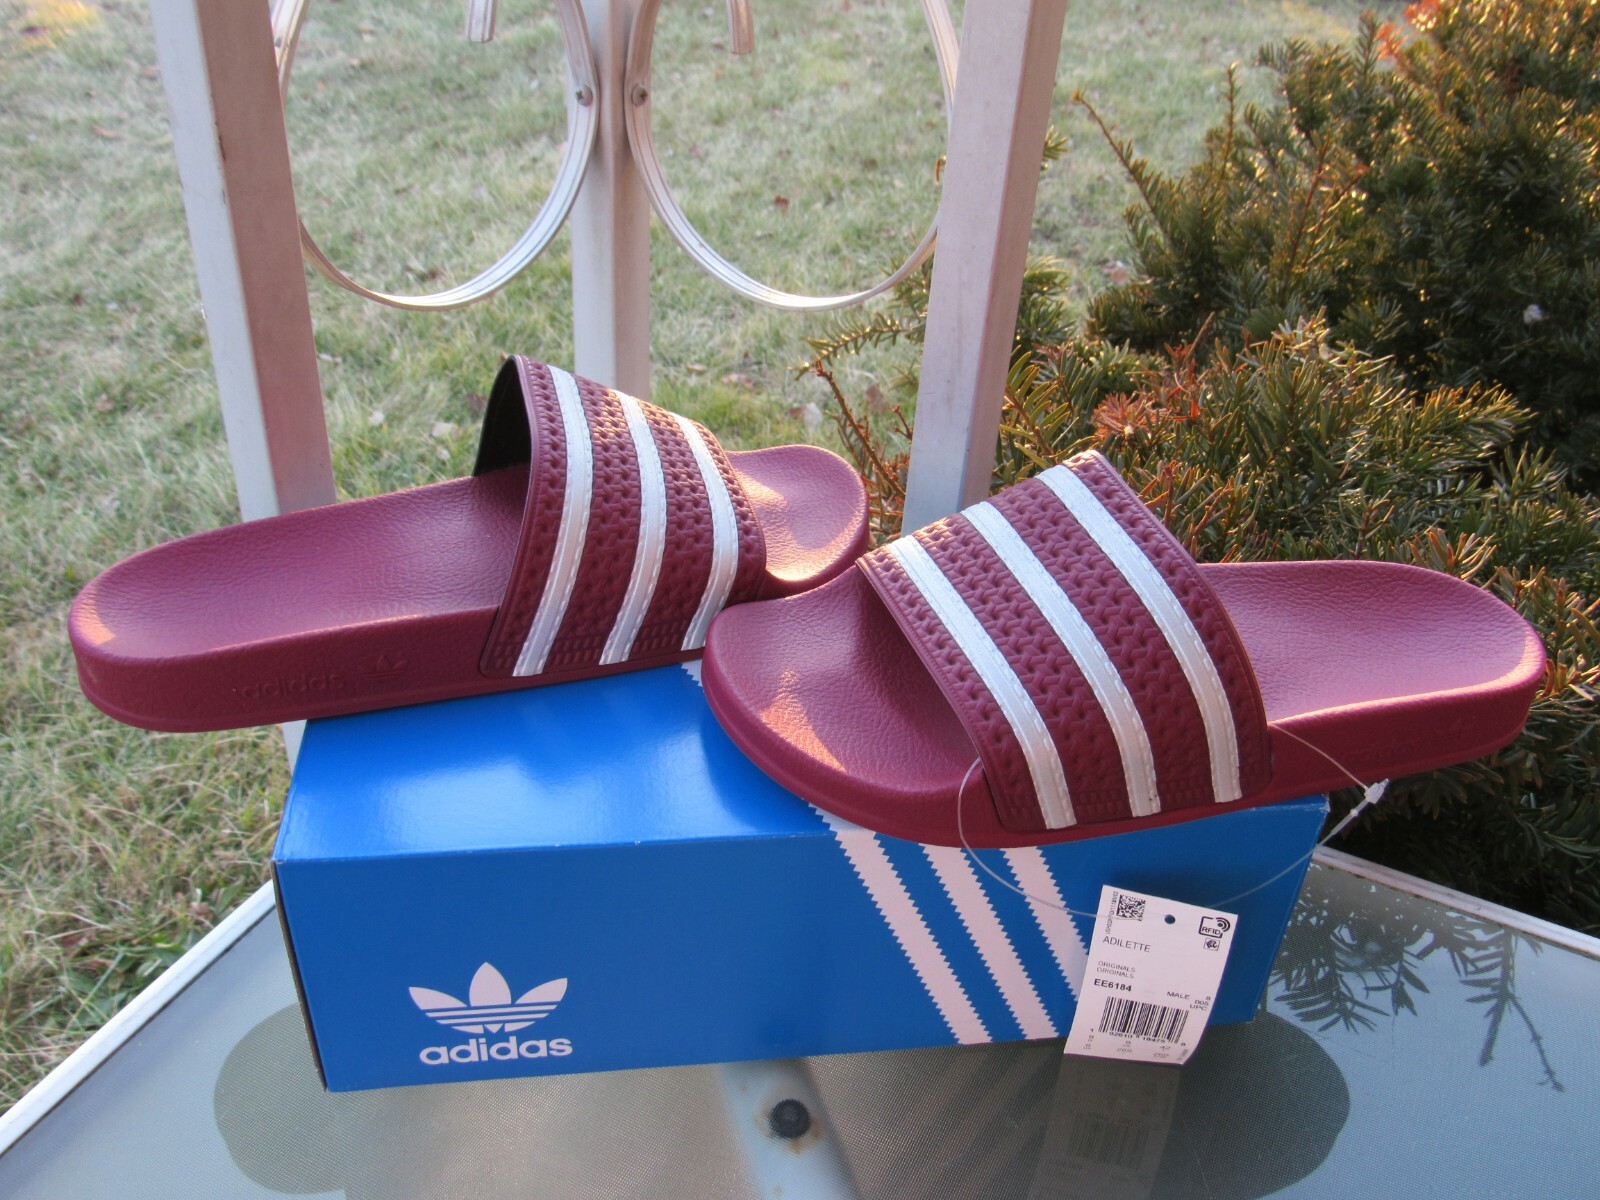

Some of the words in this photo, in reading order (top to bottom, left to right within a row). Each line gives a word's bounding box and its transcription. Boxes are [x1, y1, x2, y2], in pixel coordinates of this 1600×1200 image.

[242, 673, 345, 699] adidas
[1201, 926, 1221, 936] RFID
[1102, 935, 1151, 953] ADILETTE
[1096, 966, 1134, 979] ORIGINALS
[1097, 960, 1136, 973] ORIGINALS
[1093, 978, 1132, 992] EE6184
[1166, 991, 1191, 1000] MALE
[419, 1035, 573, 1065] adidas
